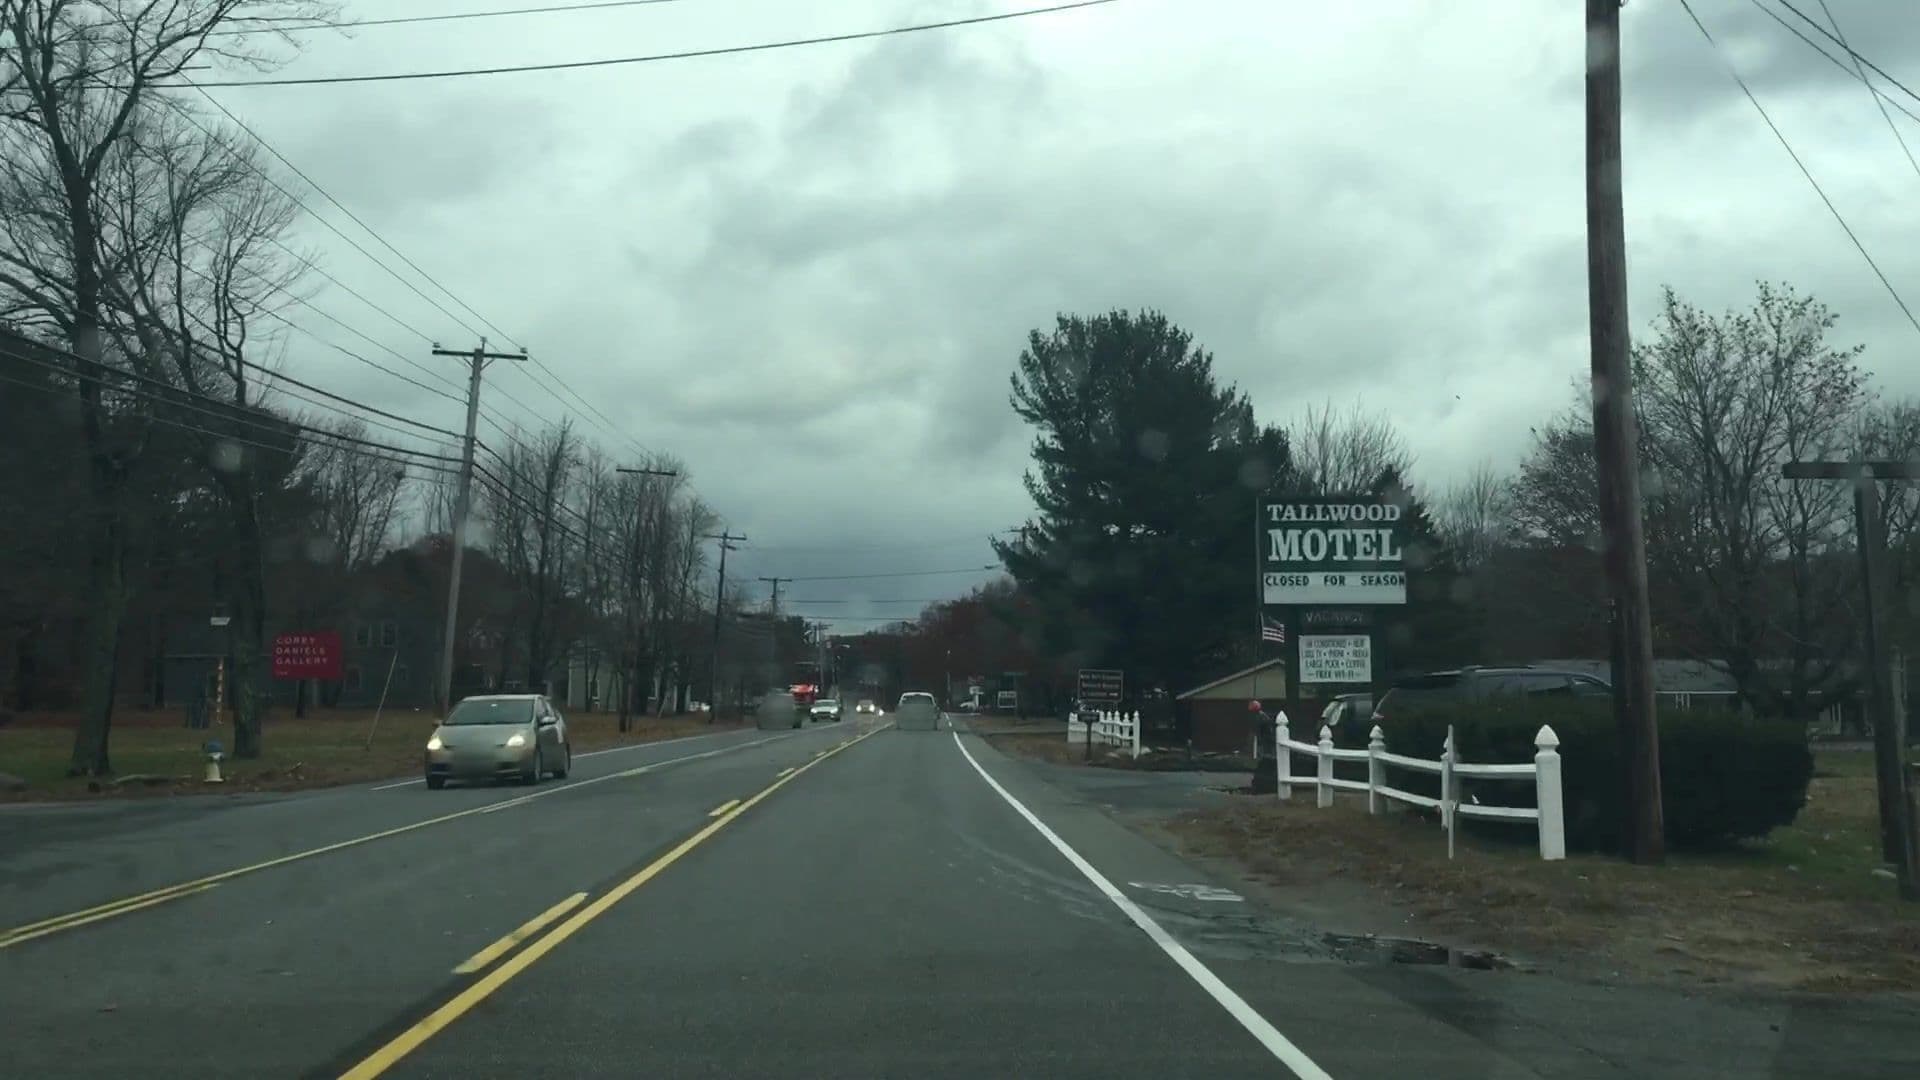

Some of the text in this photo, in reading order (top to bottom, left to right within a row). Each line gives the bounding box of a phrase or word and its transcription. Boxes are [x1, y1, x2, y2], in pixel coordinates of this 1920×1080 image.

[1267, 504, 1400, 521] TALLWOOD
[1267, 528, 1402, 561] MOTEL
[1265, 575, 1405, 586] CLOSED FOR SEASON
[275, 656, 328, 665] GALLERY
